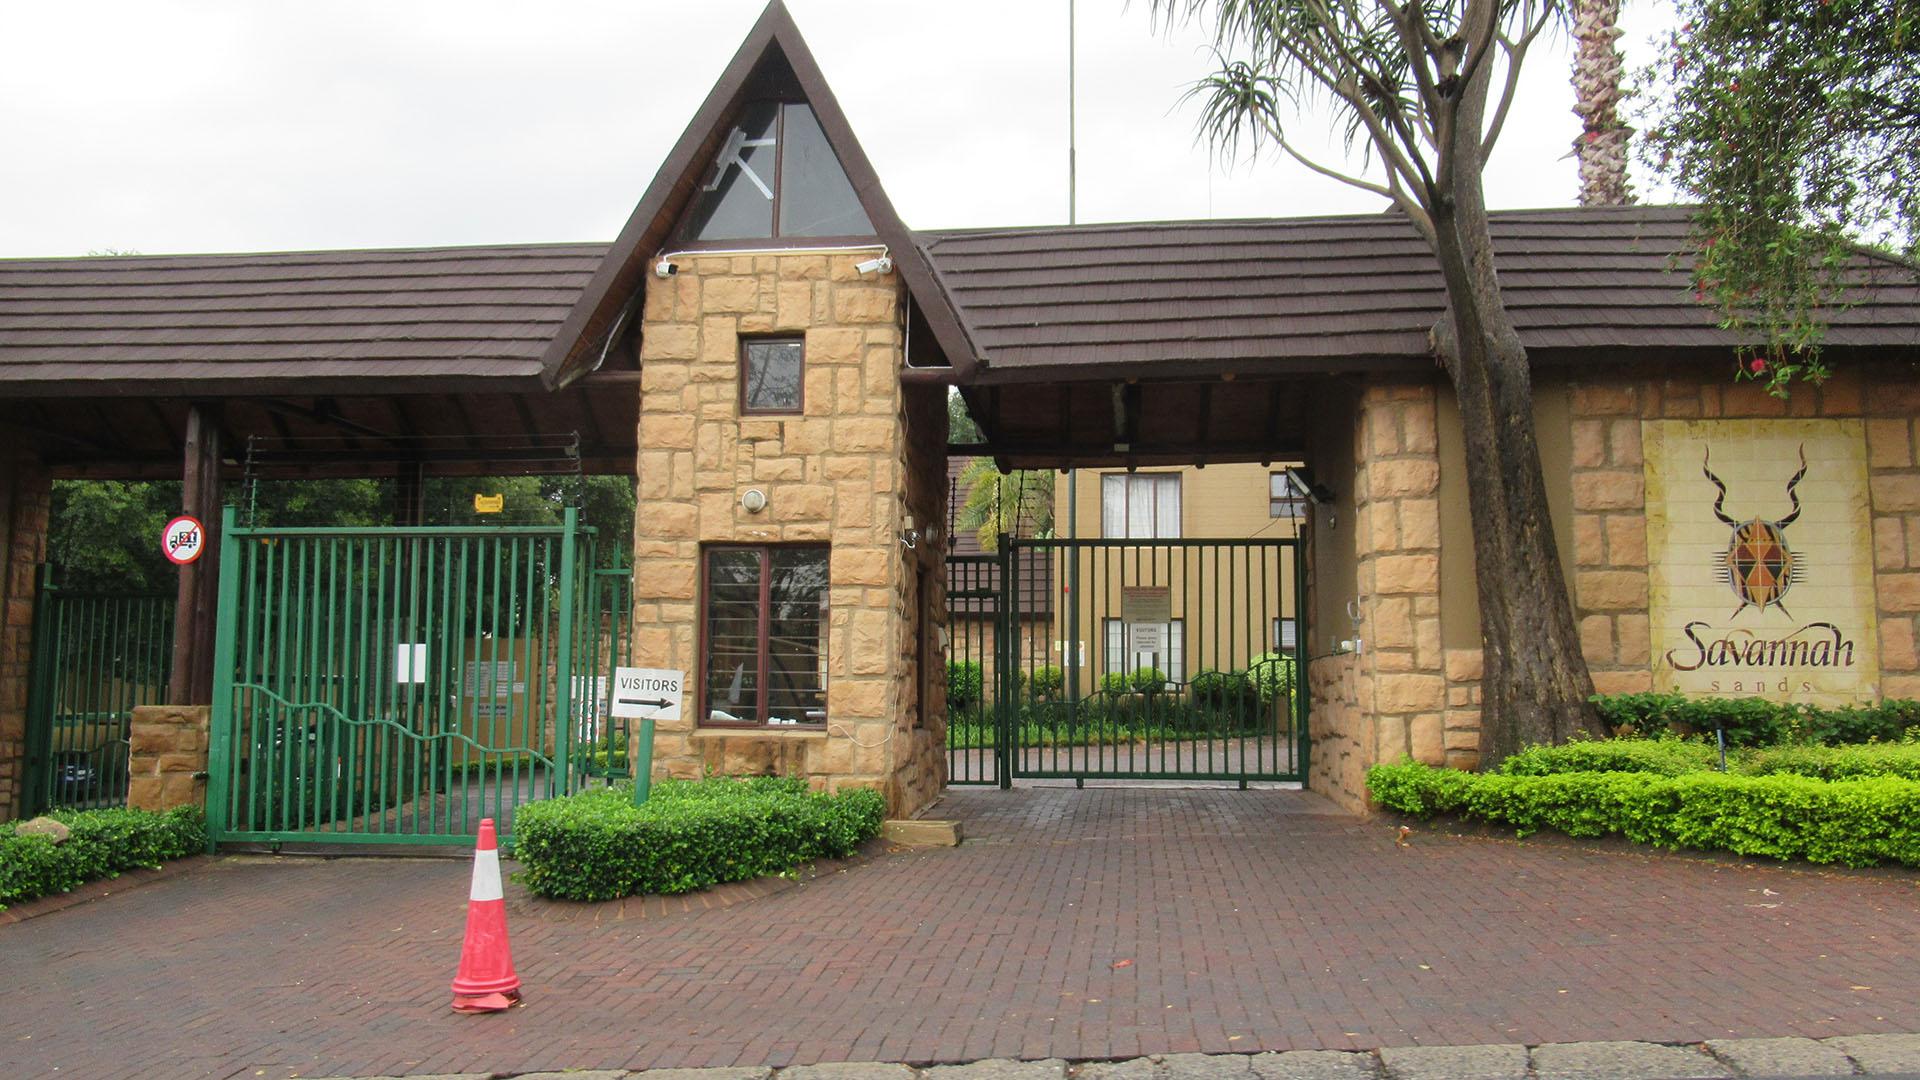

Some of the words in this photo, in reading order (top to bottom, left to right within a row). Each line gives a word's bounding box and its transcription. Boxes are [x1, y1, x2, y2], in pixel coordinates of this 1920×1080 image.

[1666, 621, 1855, 671] Savannah
[621, 677, 678, 692] VISITORS
[1711, 677, 1812, 692] sands
